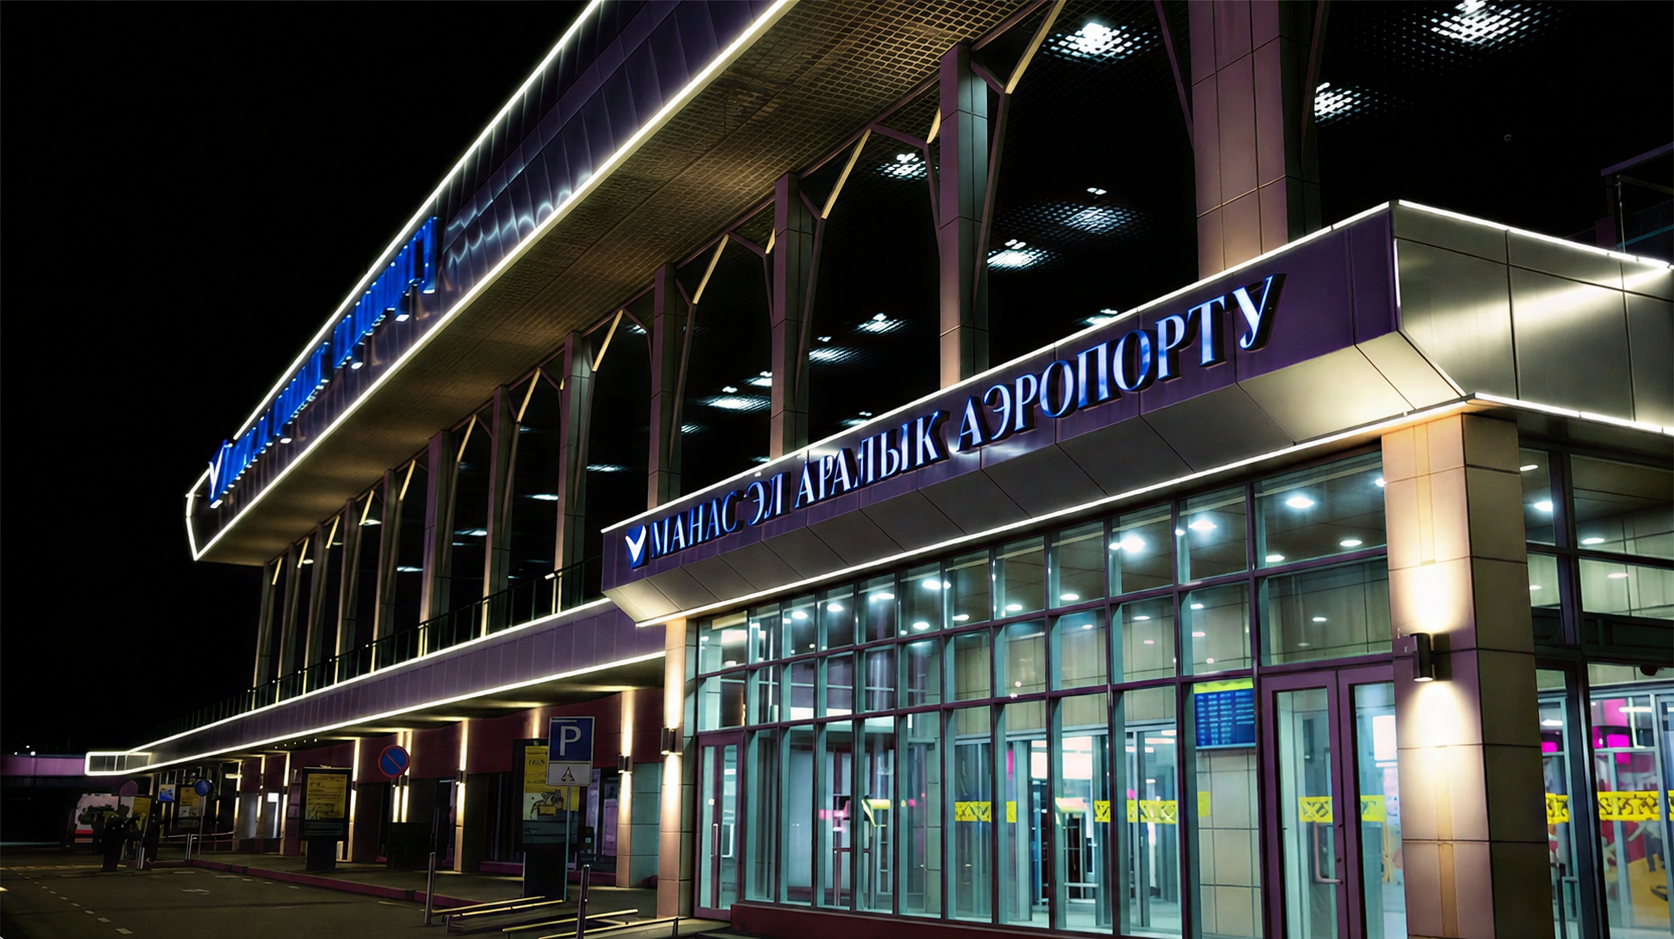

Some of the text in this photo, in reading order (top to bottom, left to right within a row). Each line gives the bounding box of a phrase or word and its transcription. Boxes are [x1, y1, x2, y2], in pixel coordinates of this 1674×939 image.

[650, 273, 1275, 559] МАНАС ЭЛ АРАЛЫК АЭРОПОРТУ
[559, 726, 582, 756] P
